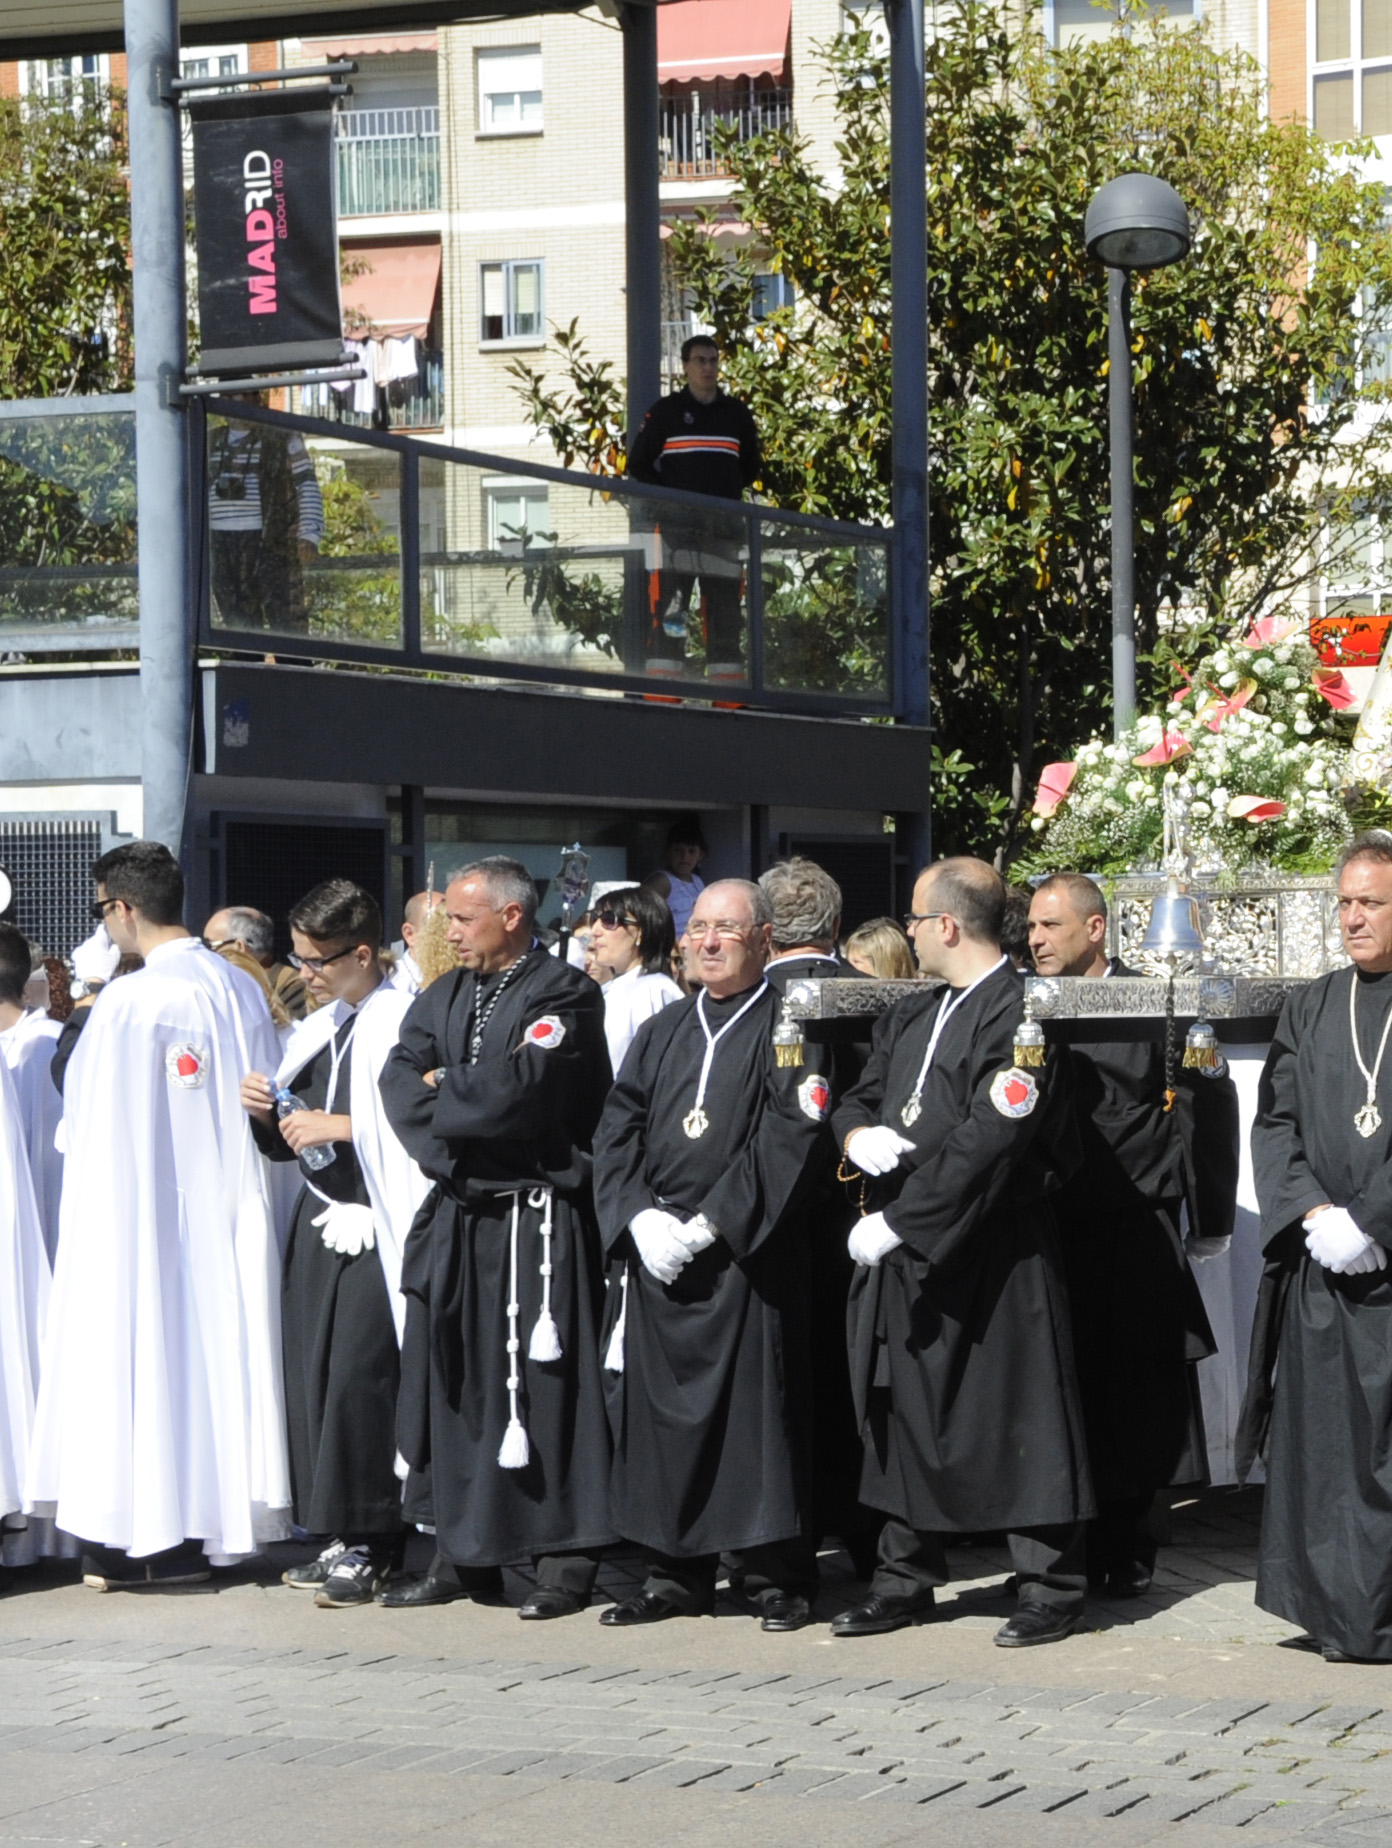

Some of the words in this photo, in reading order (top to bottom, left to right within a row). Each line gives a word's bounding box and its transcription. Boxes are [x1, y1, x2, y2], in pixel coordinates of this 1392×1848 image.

[272, 158, 284, 188] info
[243, 150, 277, 315] MADRID
[274, 193, 288, 239] about
